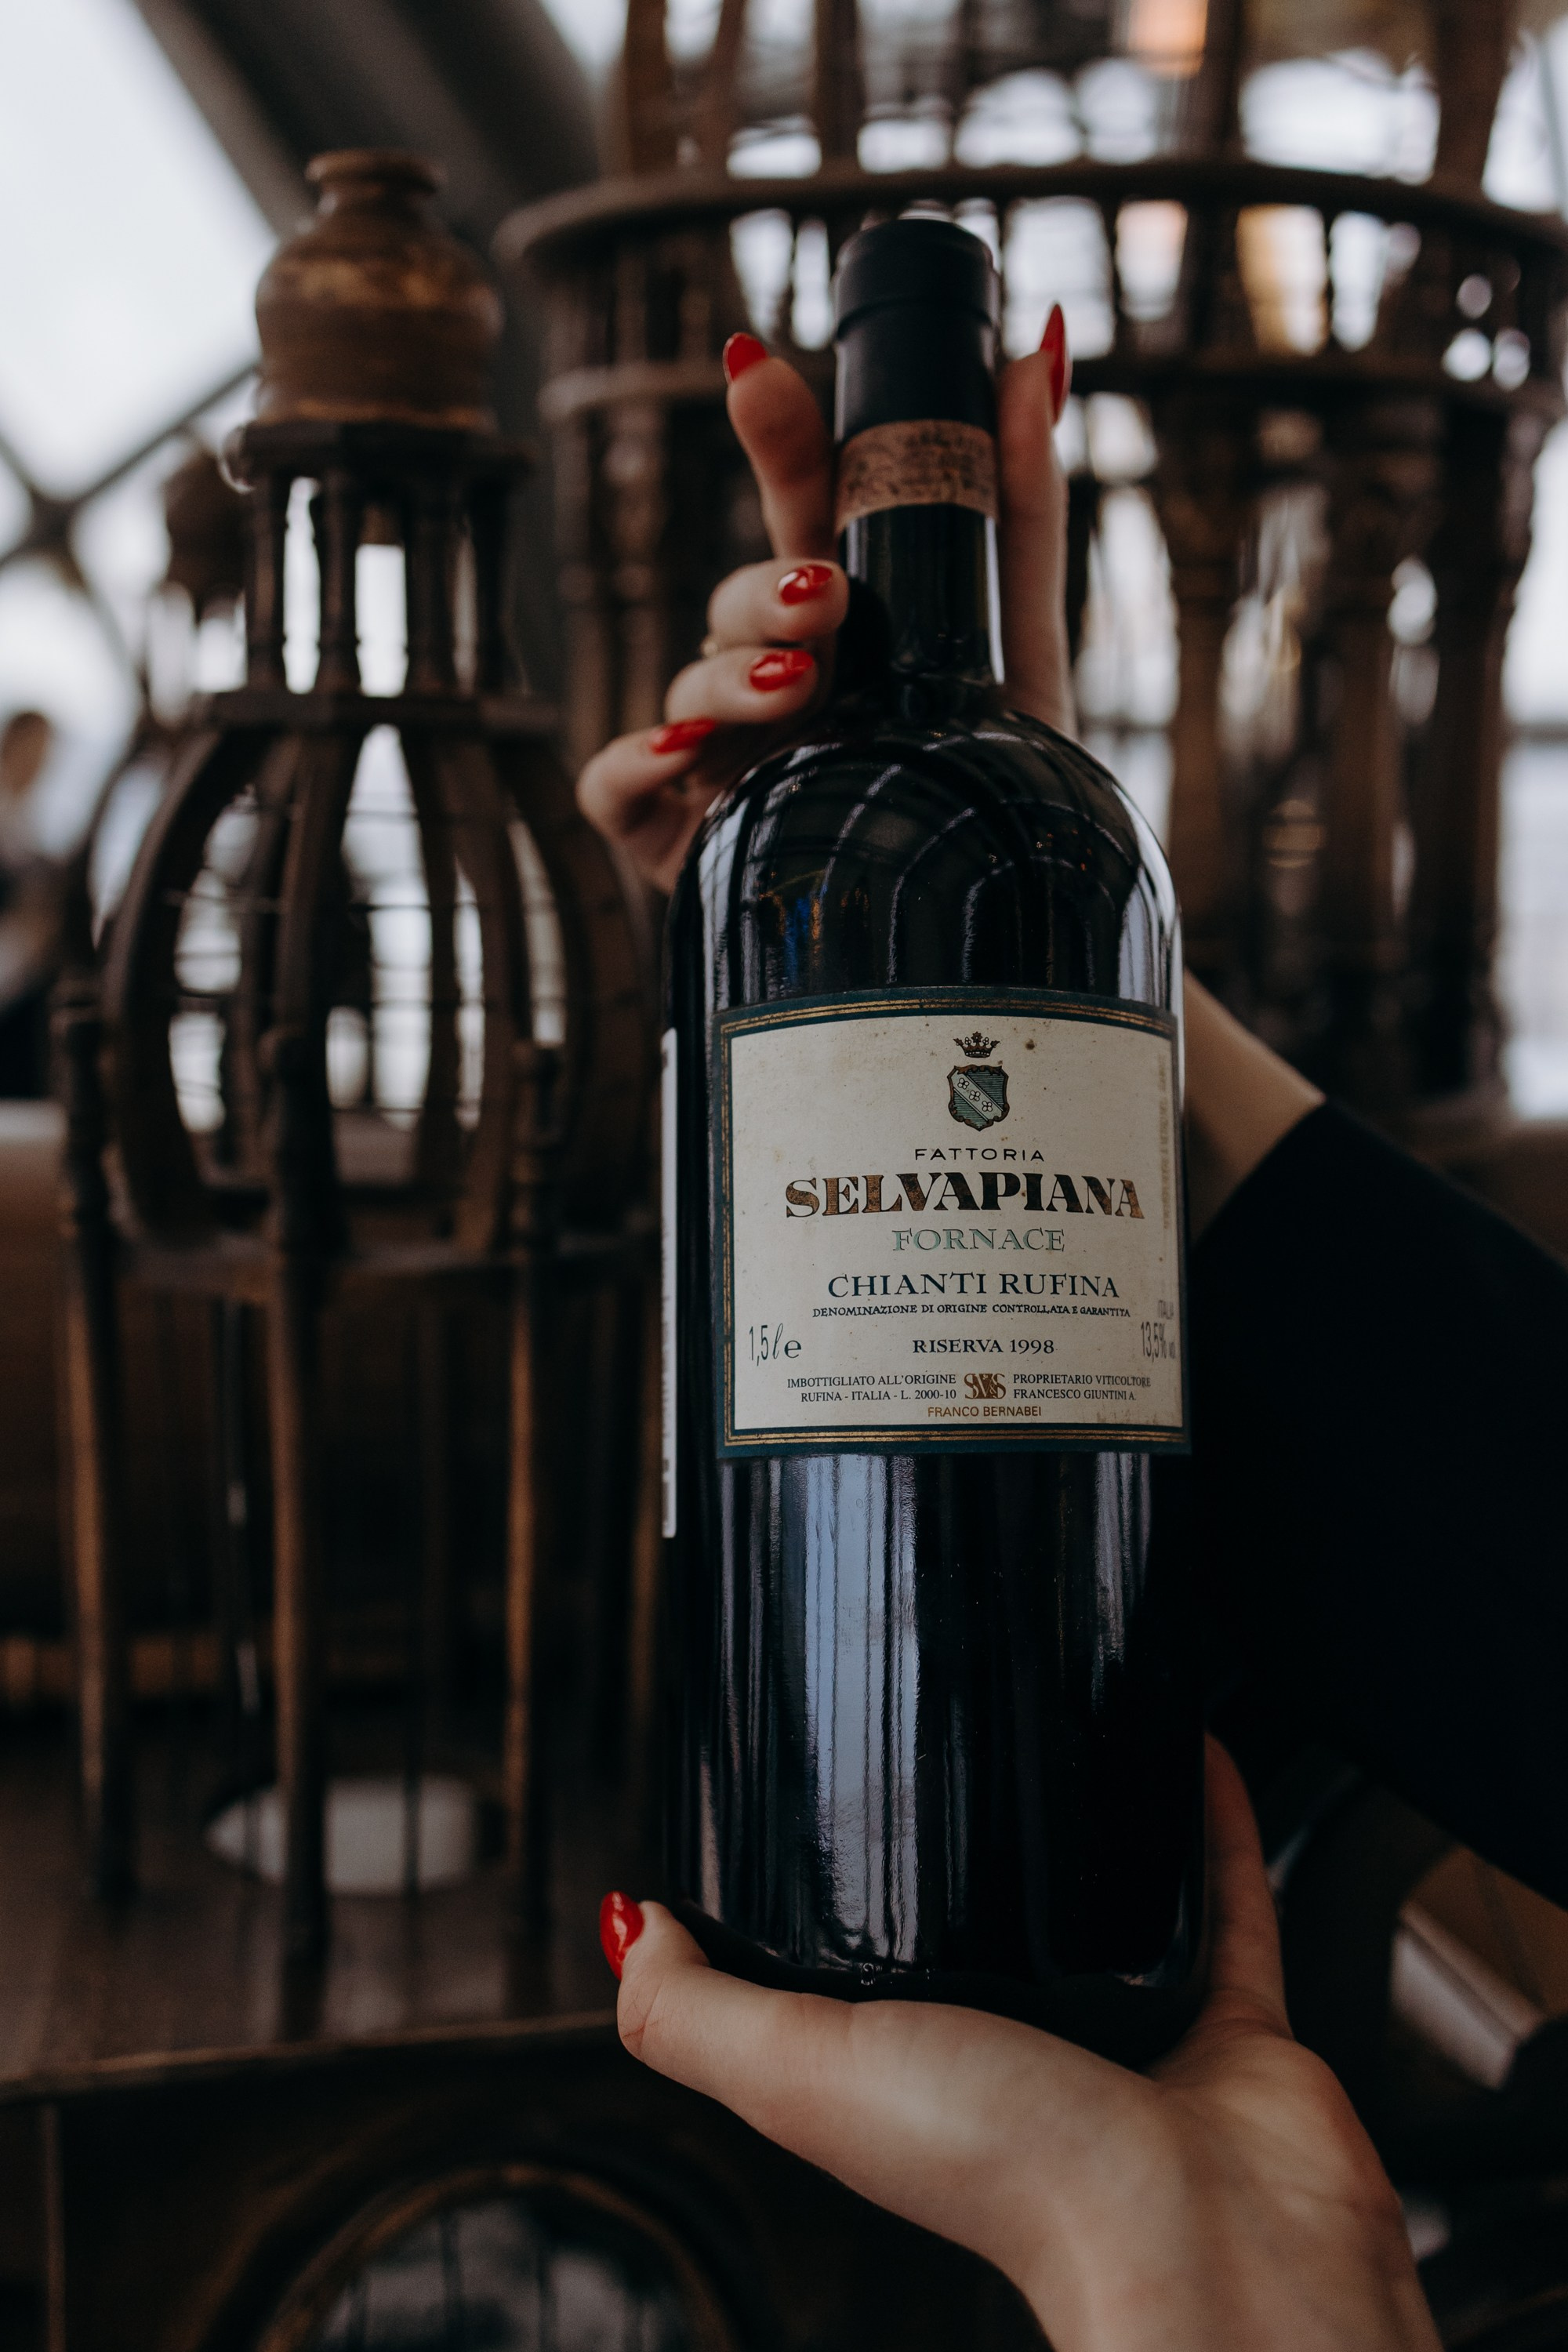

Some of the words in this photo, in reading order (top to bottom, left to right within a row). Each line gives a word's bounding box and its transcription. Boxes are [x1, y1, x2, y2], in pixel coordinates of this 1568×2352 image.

[915, 1148, 1044, 1161] FATTORIA
[786, 1172, 1145, 1219] SELVAPIANA
[892, 1228, 1065, 1252] FORNACE
[828, 1272, 986, 1298] CHIANTI
[999, 1273, 1120, 1298] RUFINA
[812, 1305, 917, 1317] DENOMINAZIONE
[937, 1304, 987, 1313] ORIGINE
[993, 1304, 1070, 1315] CONTROLLATA
[1080, 1307, 1131, 1317] GARANTITA
[913, 1338, 1004, 1354] RISERVA
[1010, 1338, 1054, 1354] 1998
[787, 1375, 876, 1388] IMBOTTIGLIATO
[878, 1374, 956, 1385] ALL'ORIGINE
[1013, 1374, 1093, 1385] PROPRIETARIO
[1096, 1375, 1151, 1387] VITICOLTORE
[801, 1392, 842, 1402] RUFINA
[851, 1390, 891, 1400] ITALIA
[901, 1390, 911, 1399] L.
[914, 1388, 956, 1399] 2000-10
[1014, 1388, 1081, 1399] FRANCESCO
[1083, 1389, 1127, 1400] GIUNTINI
[1129, 1391, 1137, 1400] A.
[927, 1406, 980, 1417] FRANCO
[983, 1406, 1041, 1417] BERNABEI
